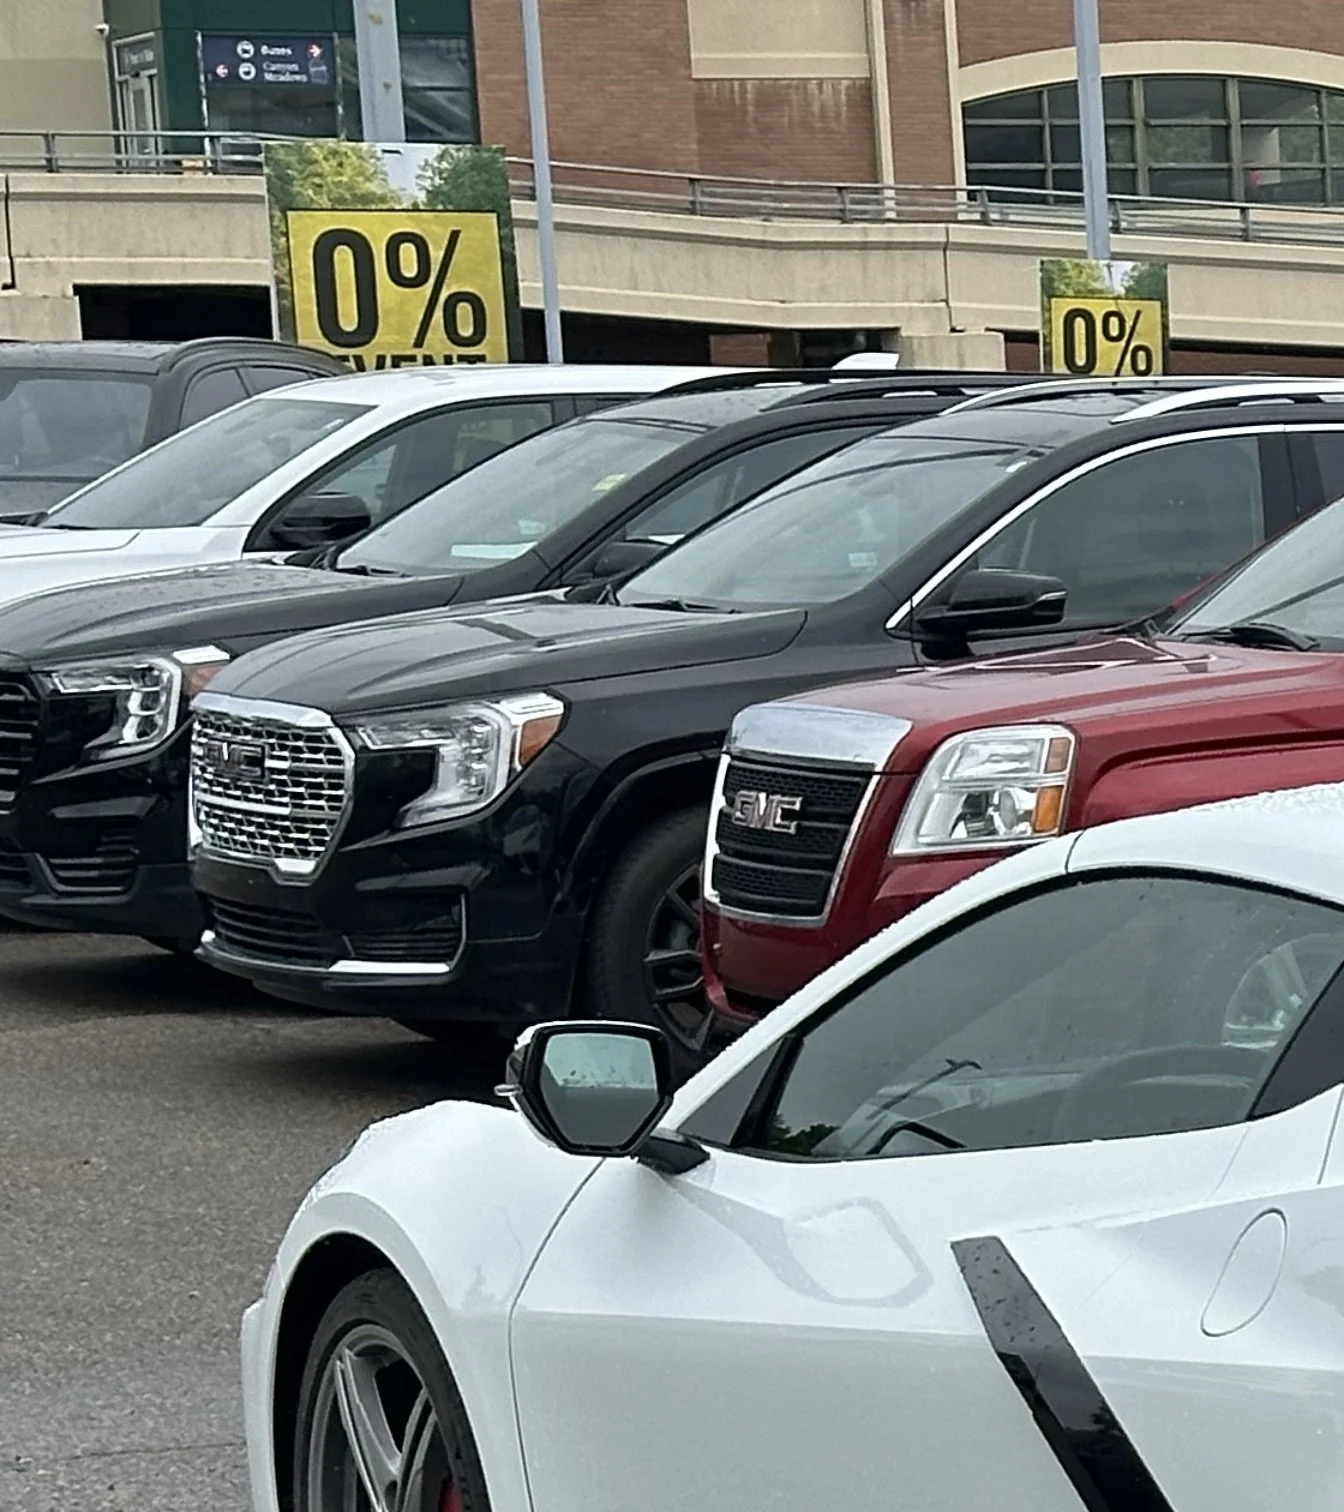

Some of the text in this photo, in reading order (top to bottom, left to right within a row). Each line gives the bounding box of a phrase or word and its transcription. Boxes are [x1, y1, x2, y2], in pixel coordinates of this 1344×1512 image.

[312, 227, 487, 349] 0%
[1063, 307, 1154, 377] 0%
[731, 789, 804, 835] GMC
